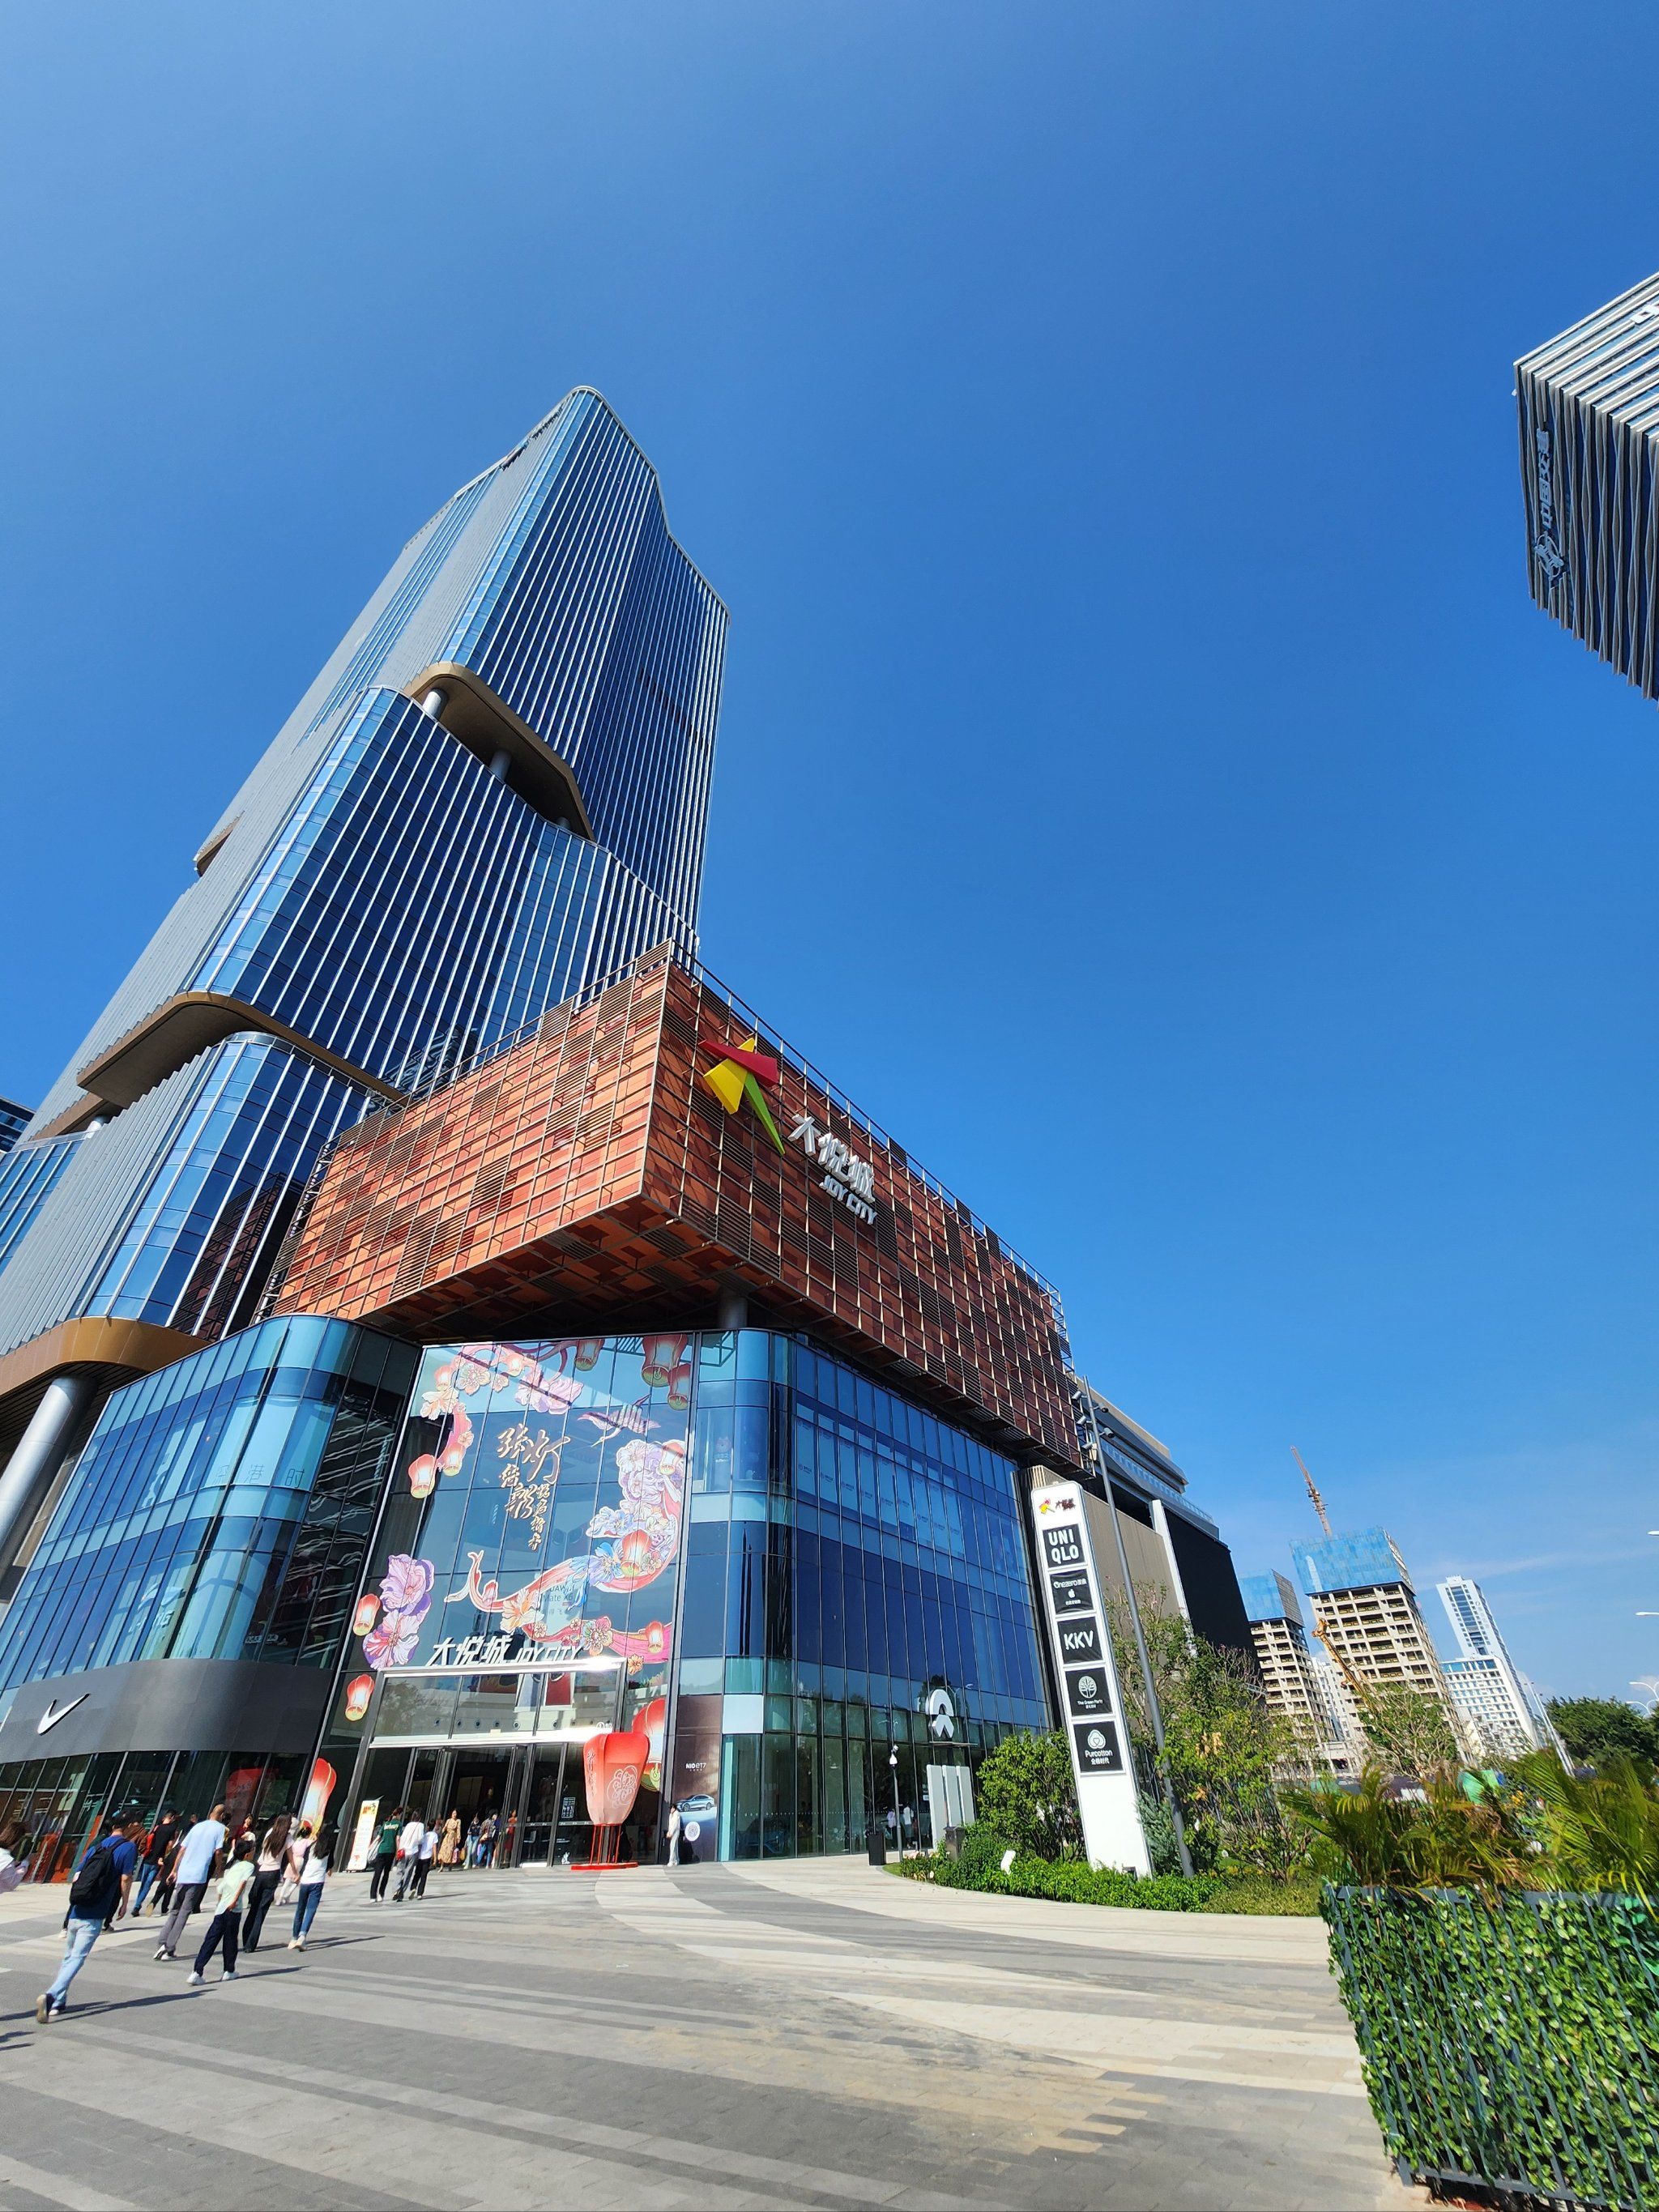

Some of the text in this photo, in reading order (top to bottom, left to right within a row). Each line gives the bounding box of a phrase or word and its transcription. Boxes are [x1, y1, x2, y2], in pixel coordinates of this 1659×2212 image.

[787, 1113, 876, 1204] 大悦城
[819, 1174, 877, 1225] JOY CITY
[1048, 1528, 1074, 1546] UNI
[1051, 1545, 1080, 1564] QLO
[426, 1634, 514, 1666] 大悦城
[1064, 1630, 1094, 1651] KKV
[544, 1645, 583, 1662] CITY
